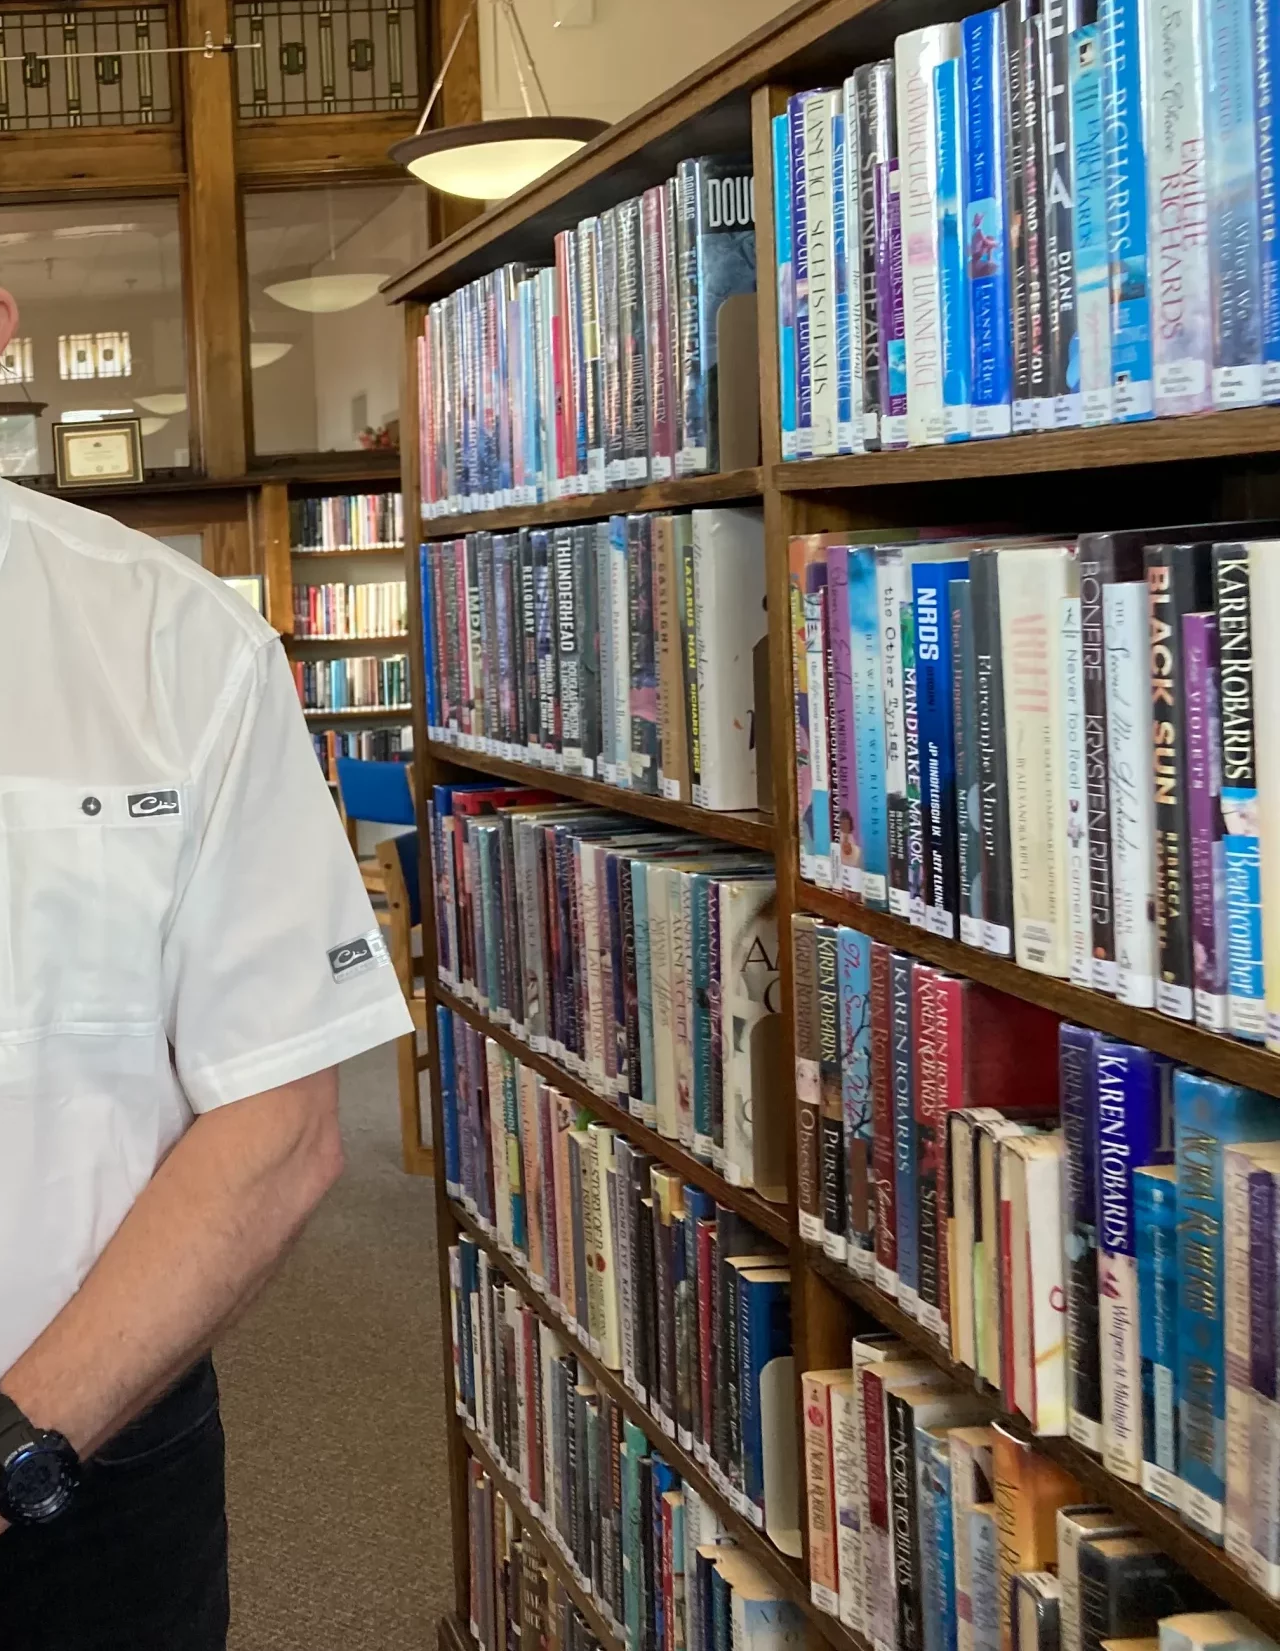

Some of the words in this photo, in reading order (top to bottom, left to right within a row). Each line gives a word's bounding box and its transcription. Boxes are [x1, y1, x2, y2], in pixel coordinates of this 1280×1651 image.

[971, 26, 984, 71] WHAT
[807, 100, 824, 161] LUANNE
[972, 76, 984, 149] MATTERS
[809, 166, 825, 201] RICE
[910, 161, 931, 217] LIGHT
[973, 153, 985, 193] MOST
[1104, 87, 1133, 252] RICHARDS
[1182, 139, 1206, 247] EMILIE
[1258, 117, 1276, 242] DAUGHTER
[861, 152, 879, 257] STONE
[1058, 251, 1073, 312] DIANE
[1161, 175, 1184, 339] RICHARDS
[1234, 221, 1251, 281] When
[913, 275, 934, 348] LUANNE
[980, 282, 992, 351] LUANNE
[1221, 271, 1234, 337] Sisters
[1237, 289, 1251, 320] We
[799, 323, 811, 383] LUANNE
[913, 351, 936, 389] RICE
[982, 357, 995, 399] RICE
[801, 388, 812, 419] RICE
[522, 566, 535, 633] RELIQUARY
[556, 537, 574, 652] THUNDERHEAD
[658, 564, 670, 656] GASLIGHT
[684, 557, 695, 627] LAZARUS
[884, 588, 893, 608] the
[1081, 561, 1102, 681] BONFIRE
[1218, 559, 1248, 652] KAREN
[469, 587, 482, 669] IMPACT
[687, 635, 697, 669] MAN
[917, 588, 939, 660] NRDS
[1147, 565, 1174, 706] BLACK
[568, 661, 577, 700] DOUGLAS
[885, 627, 897, 688] Other
[1066, 649, 1078, 702] Never
[562, 706, 570, 738] CHILD
[570, 701, 579, 739] PRESTON
[690, 684, 699, 736] RICHARD
[886, 699, 900, 762] Typist
[904, 668, 920, 785] MANDRAKE
[1190, 691, 1205, 790] VIOLETS
[1220, 659, 1253, 780] ROBARDS
[692, 739, 701, 774] PRICE
[927, 743, 938, 755] JP
[1068, 749, 1082, 789] Real
[1084, 714, 1106, 831] KRYSTEN
[1152, 721, 1177, 805] SUN
[908, 798, 924, 865] MANOR
[956, 790, 968, 827] Molly
[980, 782, 998, 857] Manor
[1017, 774, 1027, 841] ALEXANDRA
[958, 834, 971, 896] Ringwald
[1070, 855, 1083, 922] Carmen
[1089, 840, 1109, 924] RITTER
[621, 867, 633, 928] AMANDA
[697, 886, 708, 941] AMANDA
[1225, 848, 1258, 995] Beachcomber
[697, 944, 708, 983] QUICK
[795, 928, 814, 980] KAREN
[818, 935, 837, 986] KAREN
[840, 943, 860, 979] The
[820, 991, 837, 1062] ROBARDS
[894, 968, 907, 1053] KAREN
[919, 976, 936, 1036] KAREN
[919, 1038, 937, 1117] ROBARDS
[1097, 1055, 1126, 1139] KAREN
[895, 1059, 911, 1174] ROBARDS
[588, 1135, 598, 1166] THE
[799, 1108, 816, 1203] Obsession
[822, 1130, 838, 1220] PURSUIT
[590, 1170, 601, 1211] STORY
[617, 1174, 627, 1241] DIAMOND
[1101, 1141, 1130, 1249] ROBARDS
[920, 1186, 937, 1302] SHATTERED
[622, 1280, 631, 1310] KATE
[728, 1282, 737, 1316] Jamie
[623, 1319, 633, 1369] QUINN
[730, 1321, 738, 1373] Raintree
[1110, 1305, 1130, 1363] Whispers
[1112, 1382, 1131, 1438] Midnight
[810, 1449, 822, 1481] NORA
[892, 1438, 906, 1497] NORA
[896, 1505, 913, 1587] ROBERTS
